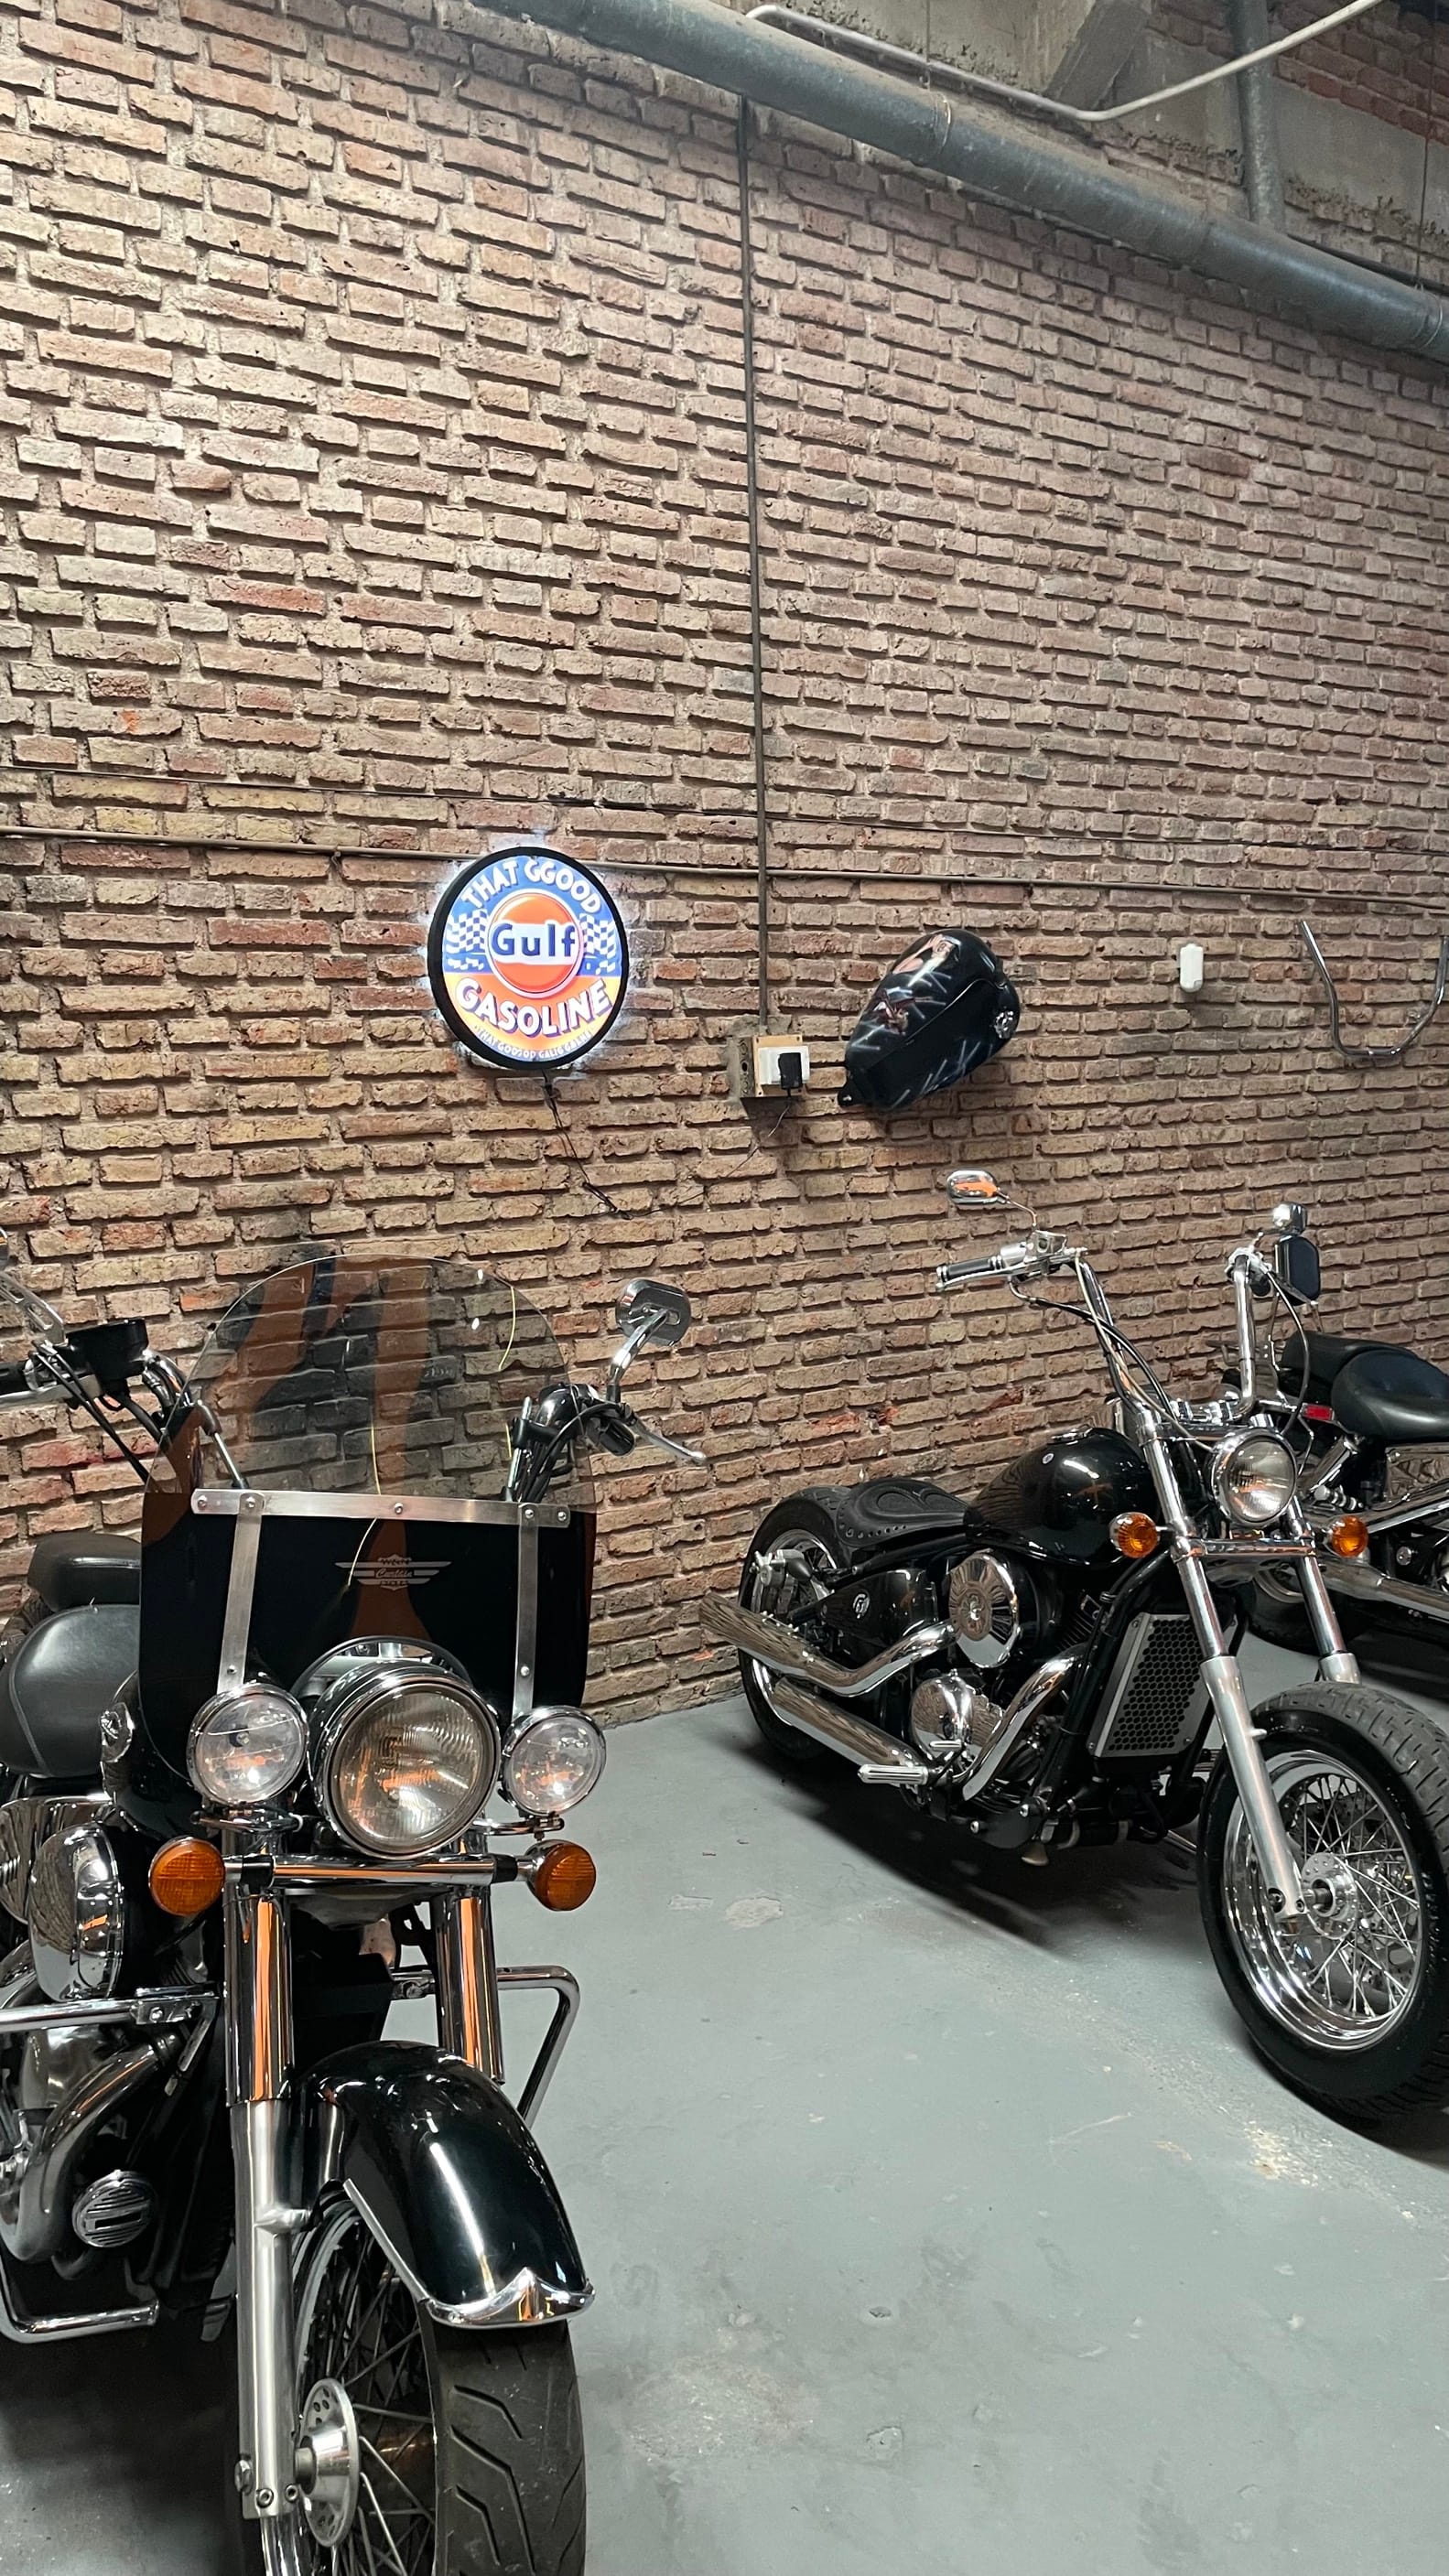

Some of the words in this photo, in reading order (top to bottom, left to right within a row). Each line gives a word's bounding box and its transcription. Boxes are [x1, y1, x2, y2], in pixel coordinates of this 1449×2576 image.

[462, 861, 518, 909] THAT
[492, 922, 576, 957] Gulf
[456, 977, 613, 1038] GASOLINE
